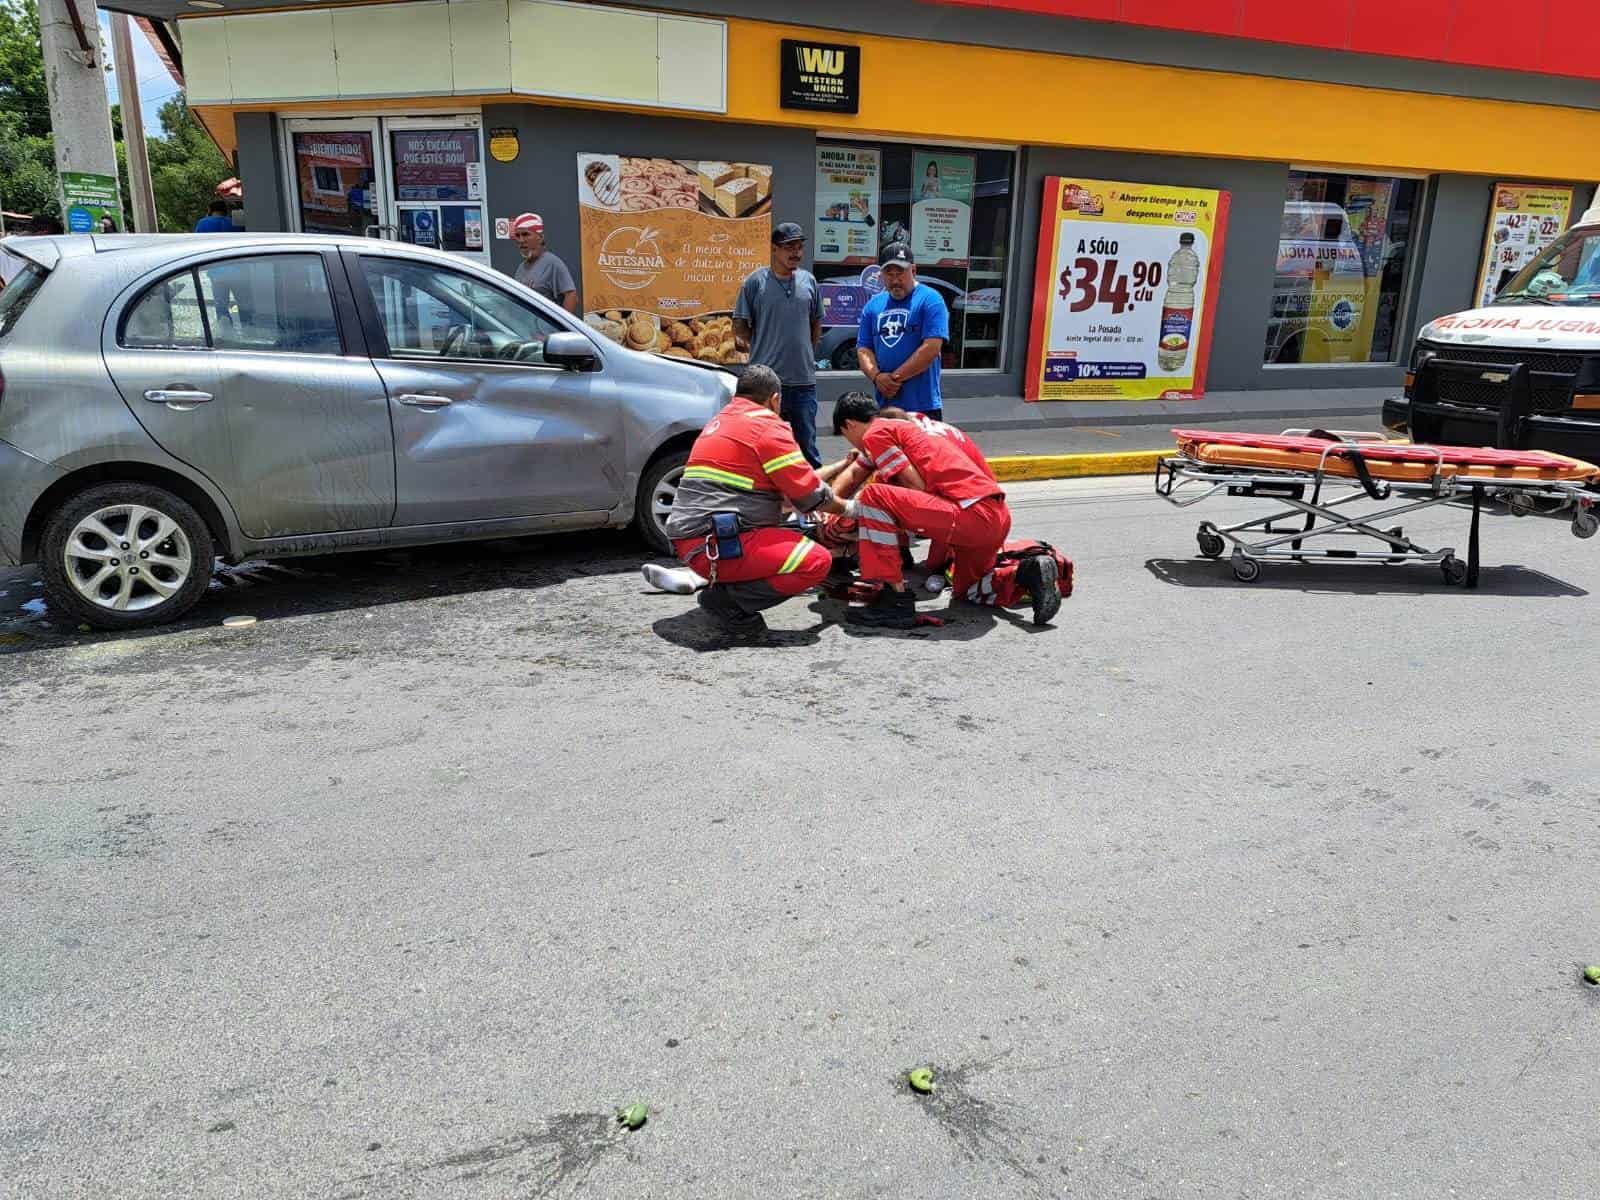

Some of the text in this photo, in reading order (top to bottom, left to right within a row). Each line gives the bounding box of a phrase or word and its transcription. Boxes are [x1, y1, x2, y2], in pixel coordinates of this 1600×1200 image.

[800, 75, 844, 86] WESTERN
[813, 84, 844, 94] UNION
[408, 140, 462, 151] NOS ENCANTA
[403, 153, 419, 165] QUE
[820, 151, 856, 161] AHORA EN
[1119, 192, 1148, 204] Ahorra
[1150, 195, 1177, 207] tiempo
[1177, 200, 1184, 209] y
[1126, 208, 1162, 218] despensa
[1077, 236, 1119, 255] A SÓLO
[695, 247, 722, 256] mejor
[728, 247, 756, 259] toque
[598, 253, 665, 268] ARTESANA
[675, 258, 687, 267] de
[692, 257, 733, 269] dulzura
[838, 295, 853, 303] spin
[1089, 325, 1122, 334] La Posada
[1053, 365, 1070, 374] spin
[1077, 364, 1101, 377] 10%
